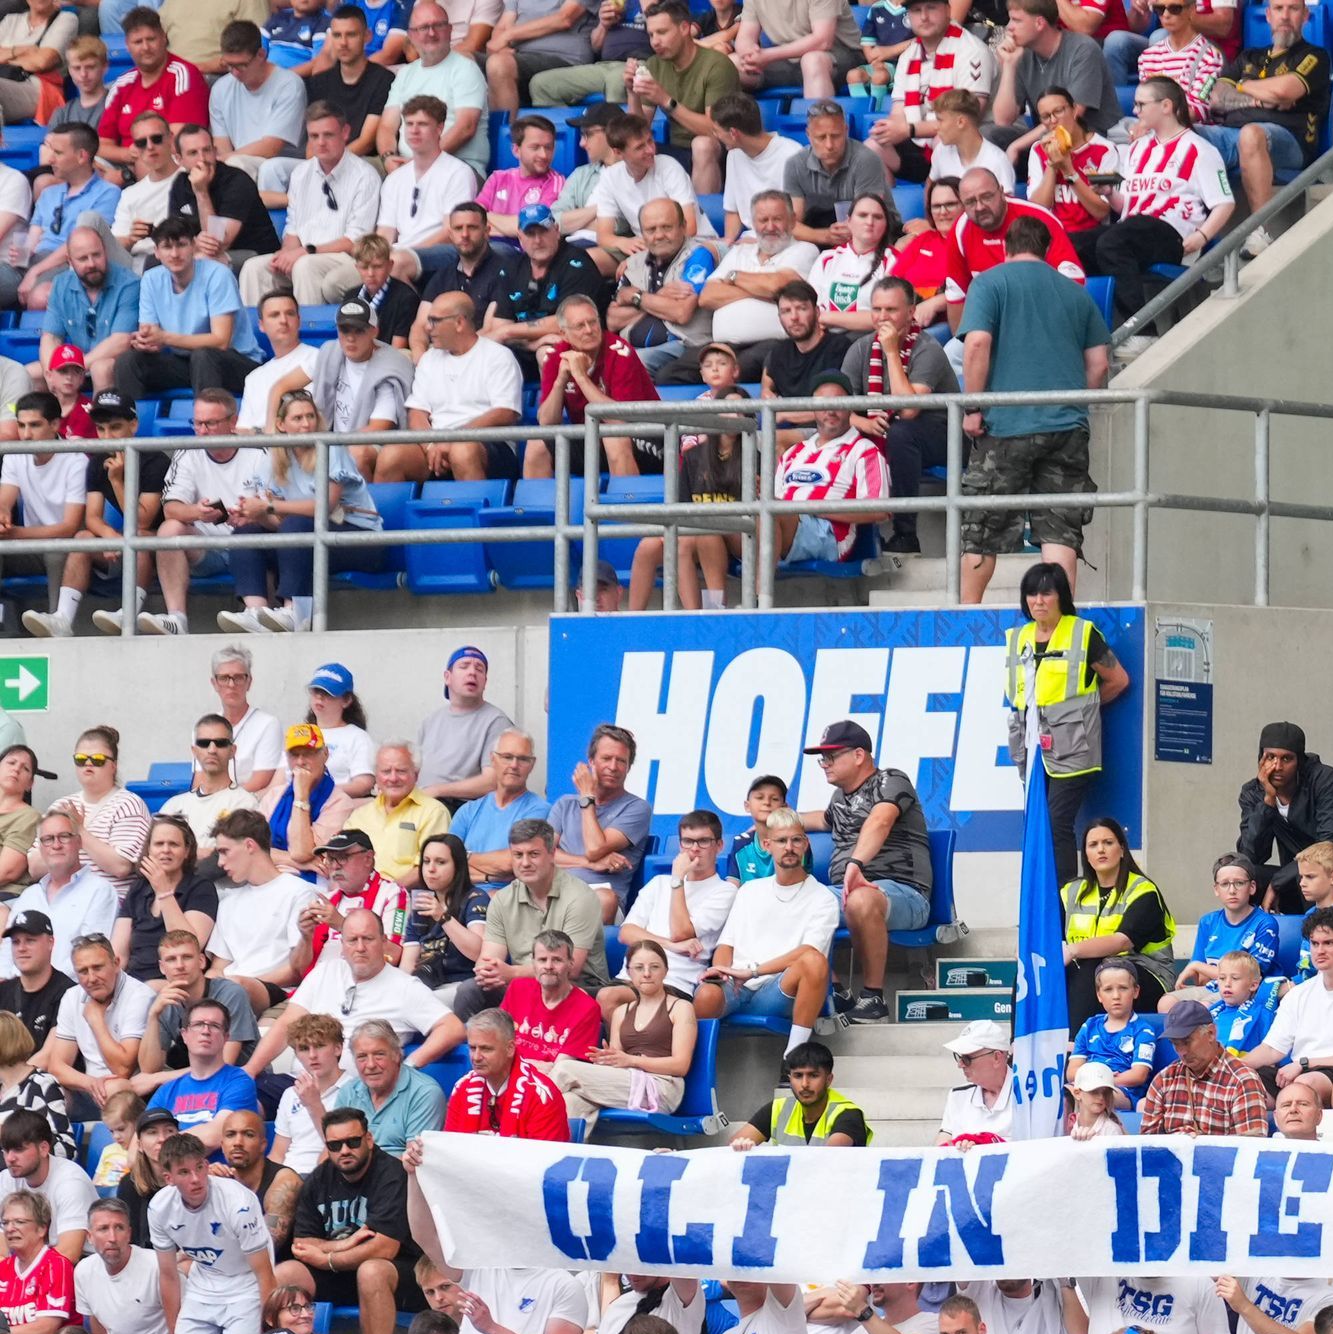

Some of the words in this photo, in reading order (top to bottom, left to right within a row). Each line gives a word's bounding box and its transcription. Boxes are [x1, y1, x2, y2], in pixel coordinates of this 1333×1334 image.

[395, 910, 406, 934] DEVK
[543, 1155, 791, 1269] OLI
[863, 1154, 1008, 1271] IN
[1118, 1278, 1175, 1317] TSG
[1253, 1283, 1303, 1323] TSG
